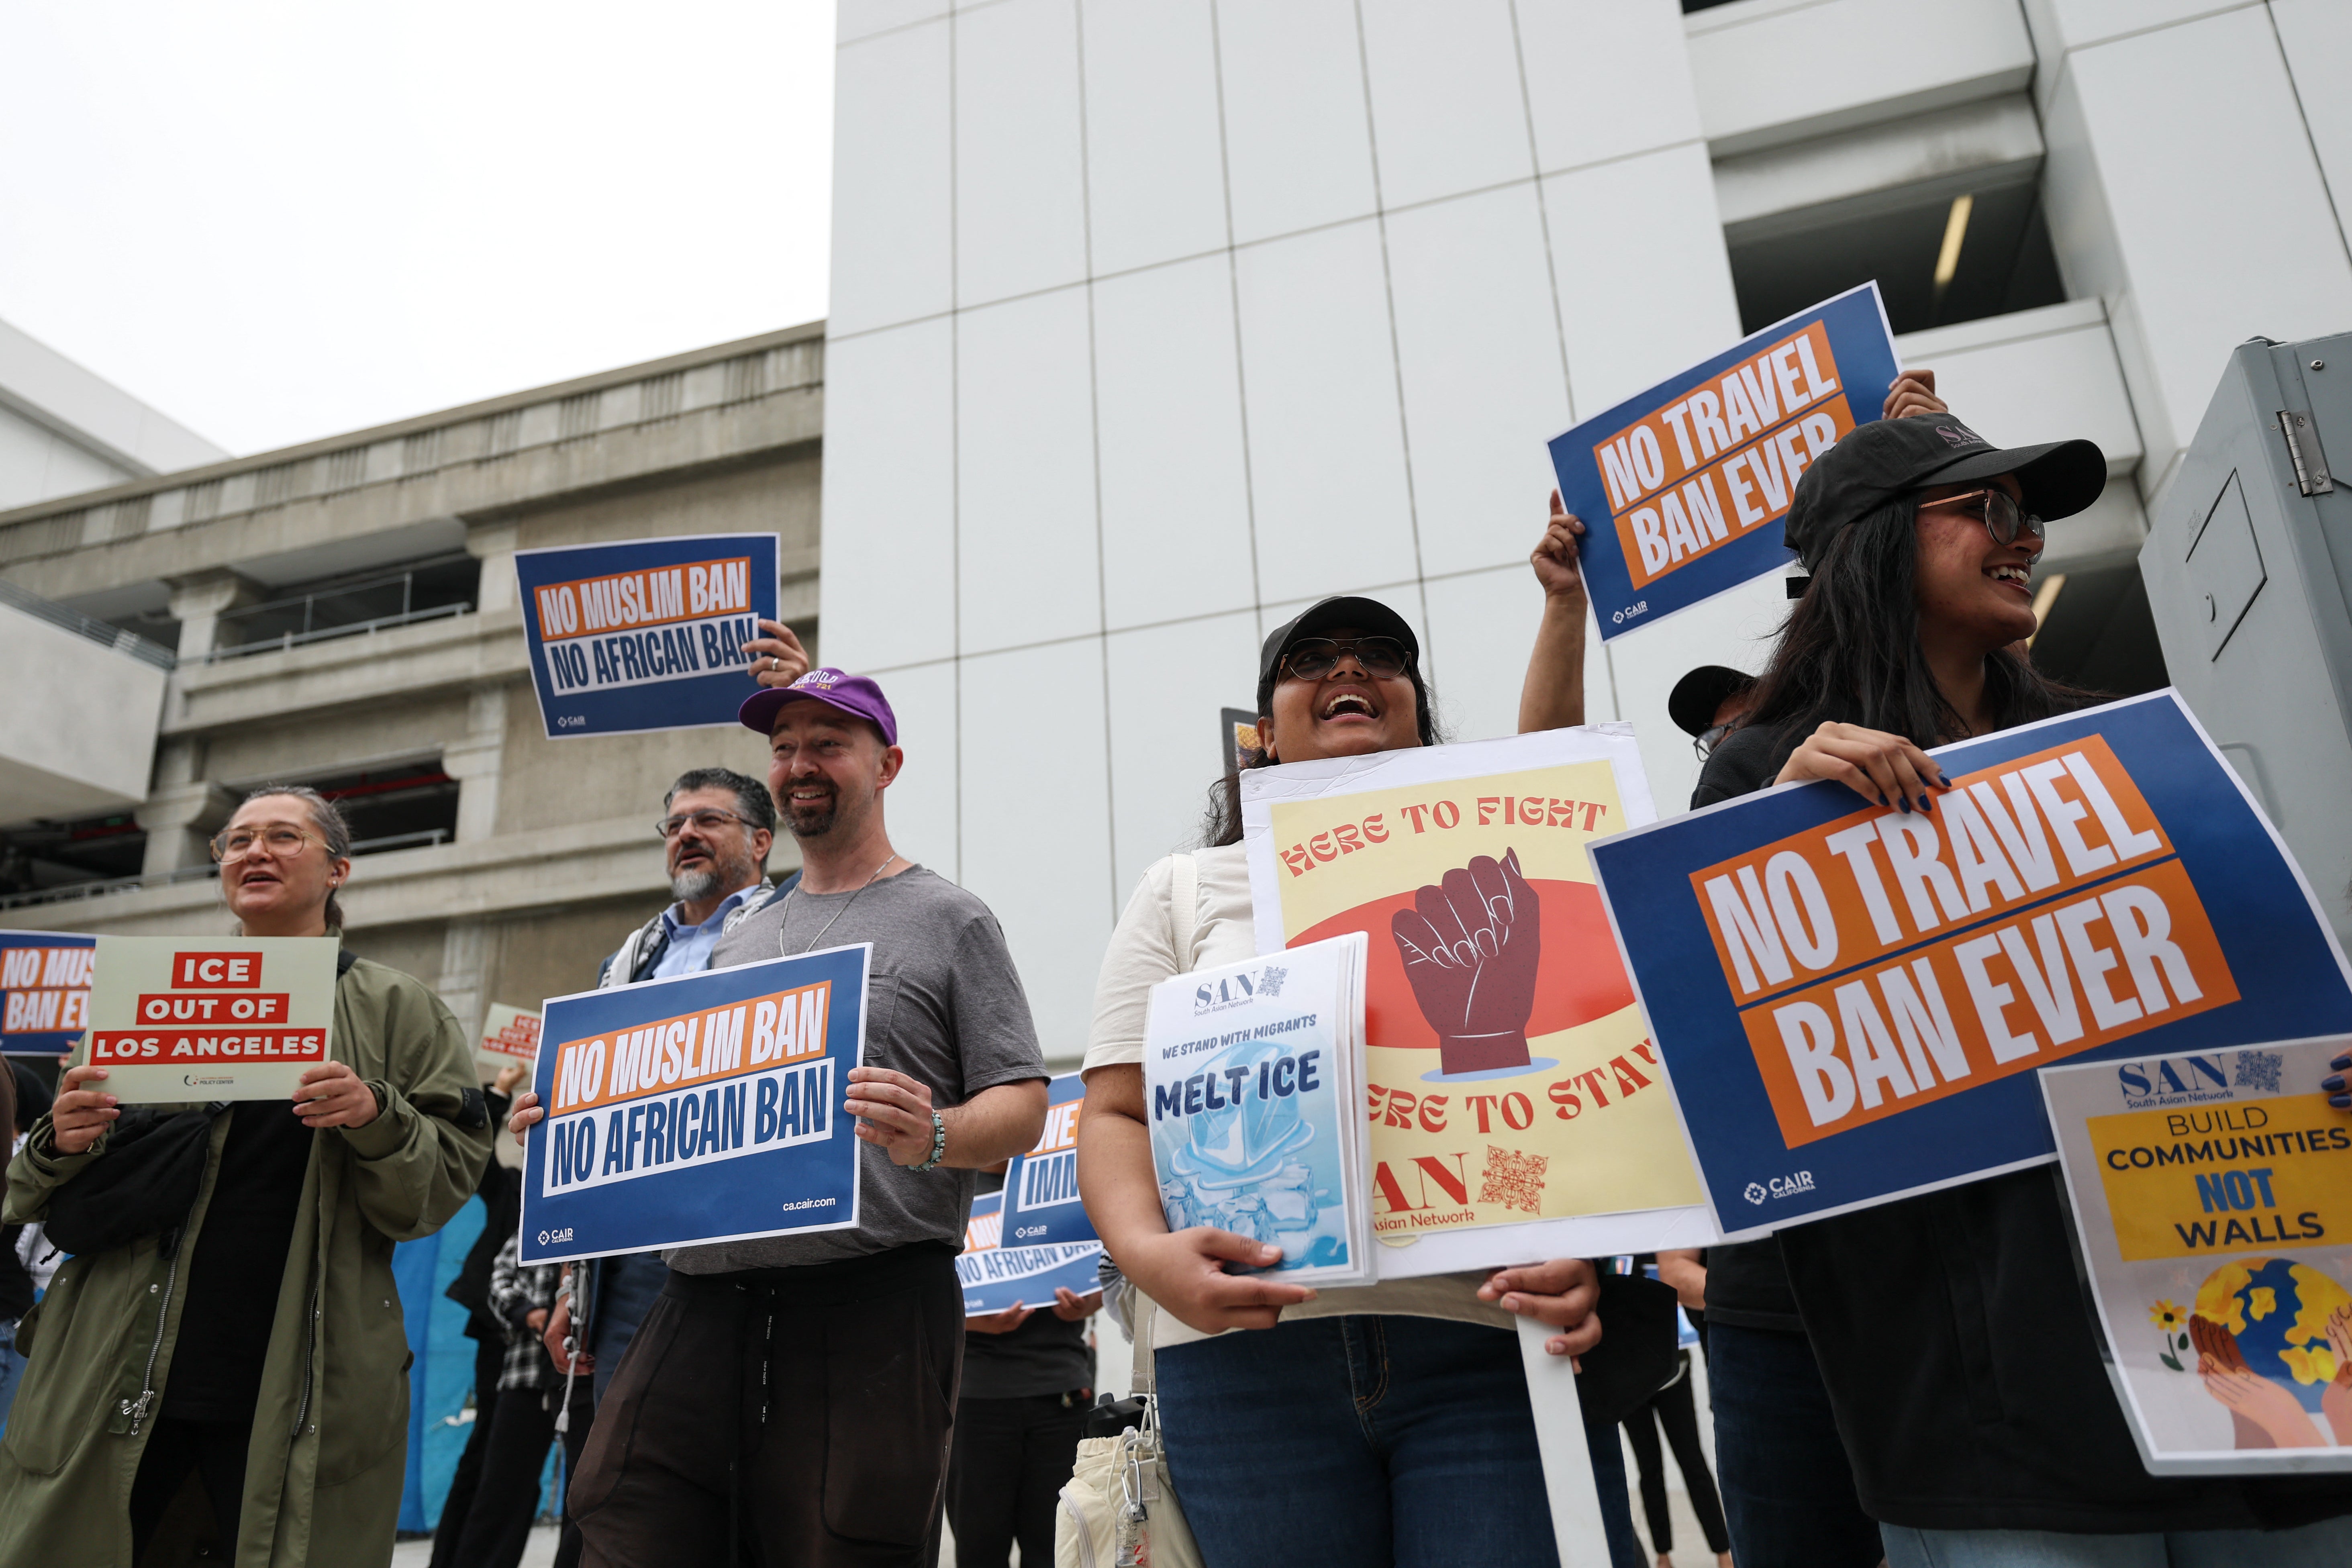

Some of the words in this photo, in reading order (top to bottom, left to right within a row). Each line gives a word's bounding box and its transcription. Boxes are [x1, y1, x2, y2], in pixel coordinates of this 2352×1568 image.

[1600, 424, 1664, 509] NO
[1661, 334, 1837, 471] TRAVEL
[1629, 472, 1729, 578] BAN
[539, 586, 577, 637] NO
[580, 569, 684, 630] MUSLIM
[689, 561, 746, 612] BAN
[1625, 600, 1648, 615] CAIR
[551, 643, 589, 690] NO
[592, 625, 699, 685] AFRICAN
[701, 618, 757, 669] BAN
[1278, 813, 1390, 878] HERE
[1401, 800, 1461, 834] TO
[1477, 796, 1608, 832] FIGHT
[1703, 850, 1839, 995] NO
[1824, 751, 2163, 946] TRAVEL
[1, 949, 41, 988] NO
[184, 959, 250, 982] ICE
[145, 999, 219, 1020] OUT
[231, 998, 277, 1019] OF
[1194, 970, 1259, 1010] SAN
[1194, 1008, 1210, 1017] South
[1211, 1004, 1227, 1013] Asian
[1228, 997, 1254, 1009] Network
[1772, 956, 1972, 1128] BAN
[1953, 884, 2205, 1066] EVER
[5, 990, 62, 1031] BAN
[96, 1038, 160, 1058] LOS
[171, 1036, 319, 1057] ANGELES
[557, 1040, 606, 1109] NO
[609, 1006, 747, 1097] MUSLIM
[749, 987, 826, 1065] BAN
[1162, 1045, 1179, 1060] WE
[1181, 1037, 1218, 1056] STAND
[1221, 1029, 1252, 1046] WITH
[1254, 1014, 1317, 1041] MIGRANTS
[1155, 1064, 1250, 1121] MELT
[1259, 1050, 1321, 1100] ICE
[2118, 1054, 2228, 1099] SAN
[1368, 1084, 1449, 1133] ERE
[1466, 1092, 1534, 1133] TO
[2127, 1097, 2156, 1109] South
[2160, 1094, 2186, 1105] Asian
[2189, 1089, 2234, 1102] Network
[551, 1117, 596, 1188] NO
[602, 1082, 747, 1176] AFRICAN
[754, 1064, 827, 1145] BAN
[2167, 1107, 2268, 1136] BUILD
[2107, 1127, 2351, 1171] COMMUNITIES
[1373, 1152, 1470, 1215] AN
[1769, 1170, 1814, 1193] CAIR
[1772, 1184, 1816, 1199] CALIFORNIA
[2195, 1168, 2276, 1213] NOT
[783, 1197, 836, 1211] ca.cair.com
[1411, 1208, 1475, 1227] Network
[551, 1228, 573, 1239] CAIR
[1027, 1225, 1047, 1234] CAIR
[2174, 1212, 2325, 1248] WALLS
[956, 1257, 982, 1284] NO
[983, 1246, 1059, 1279] AFRICAN
